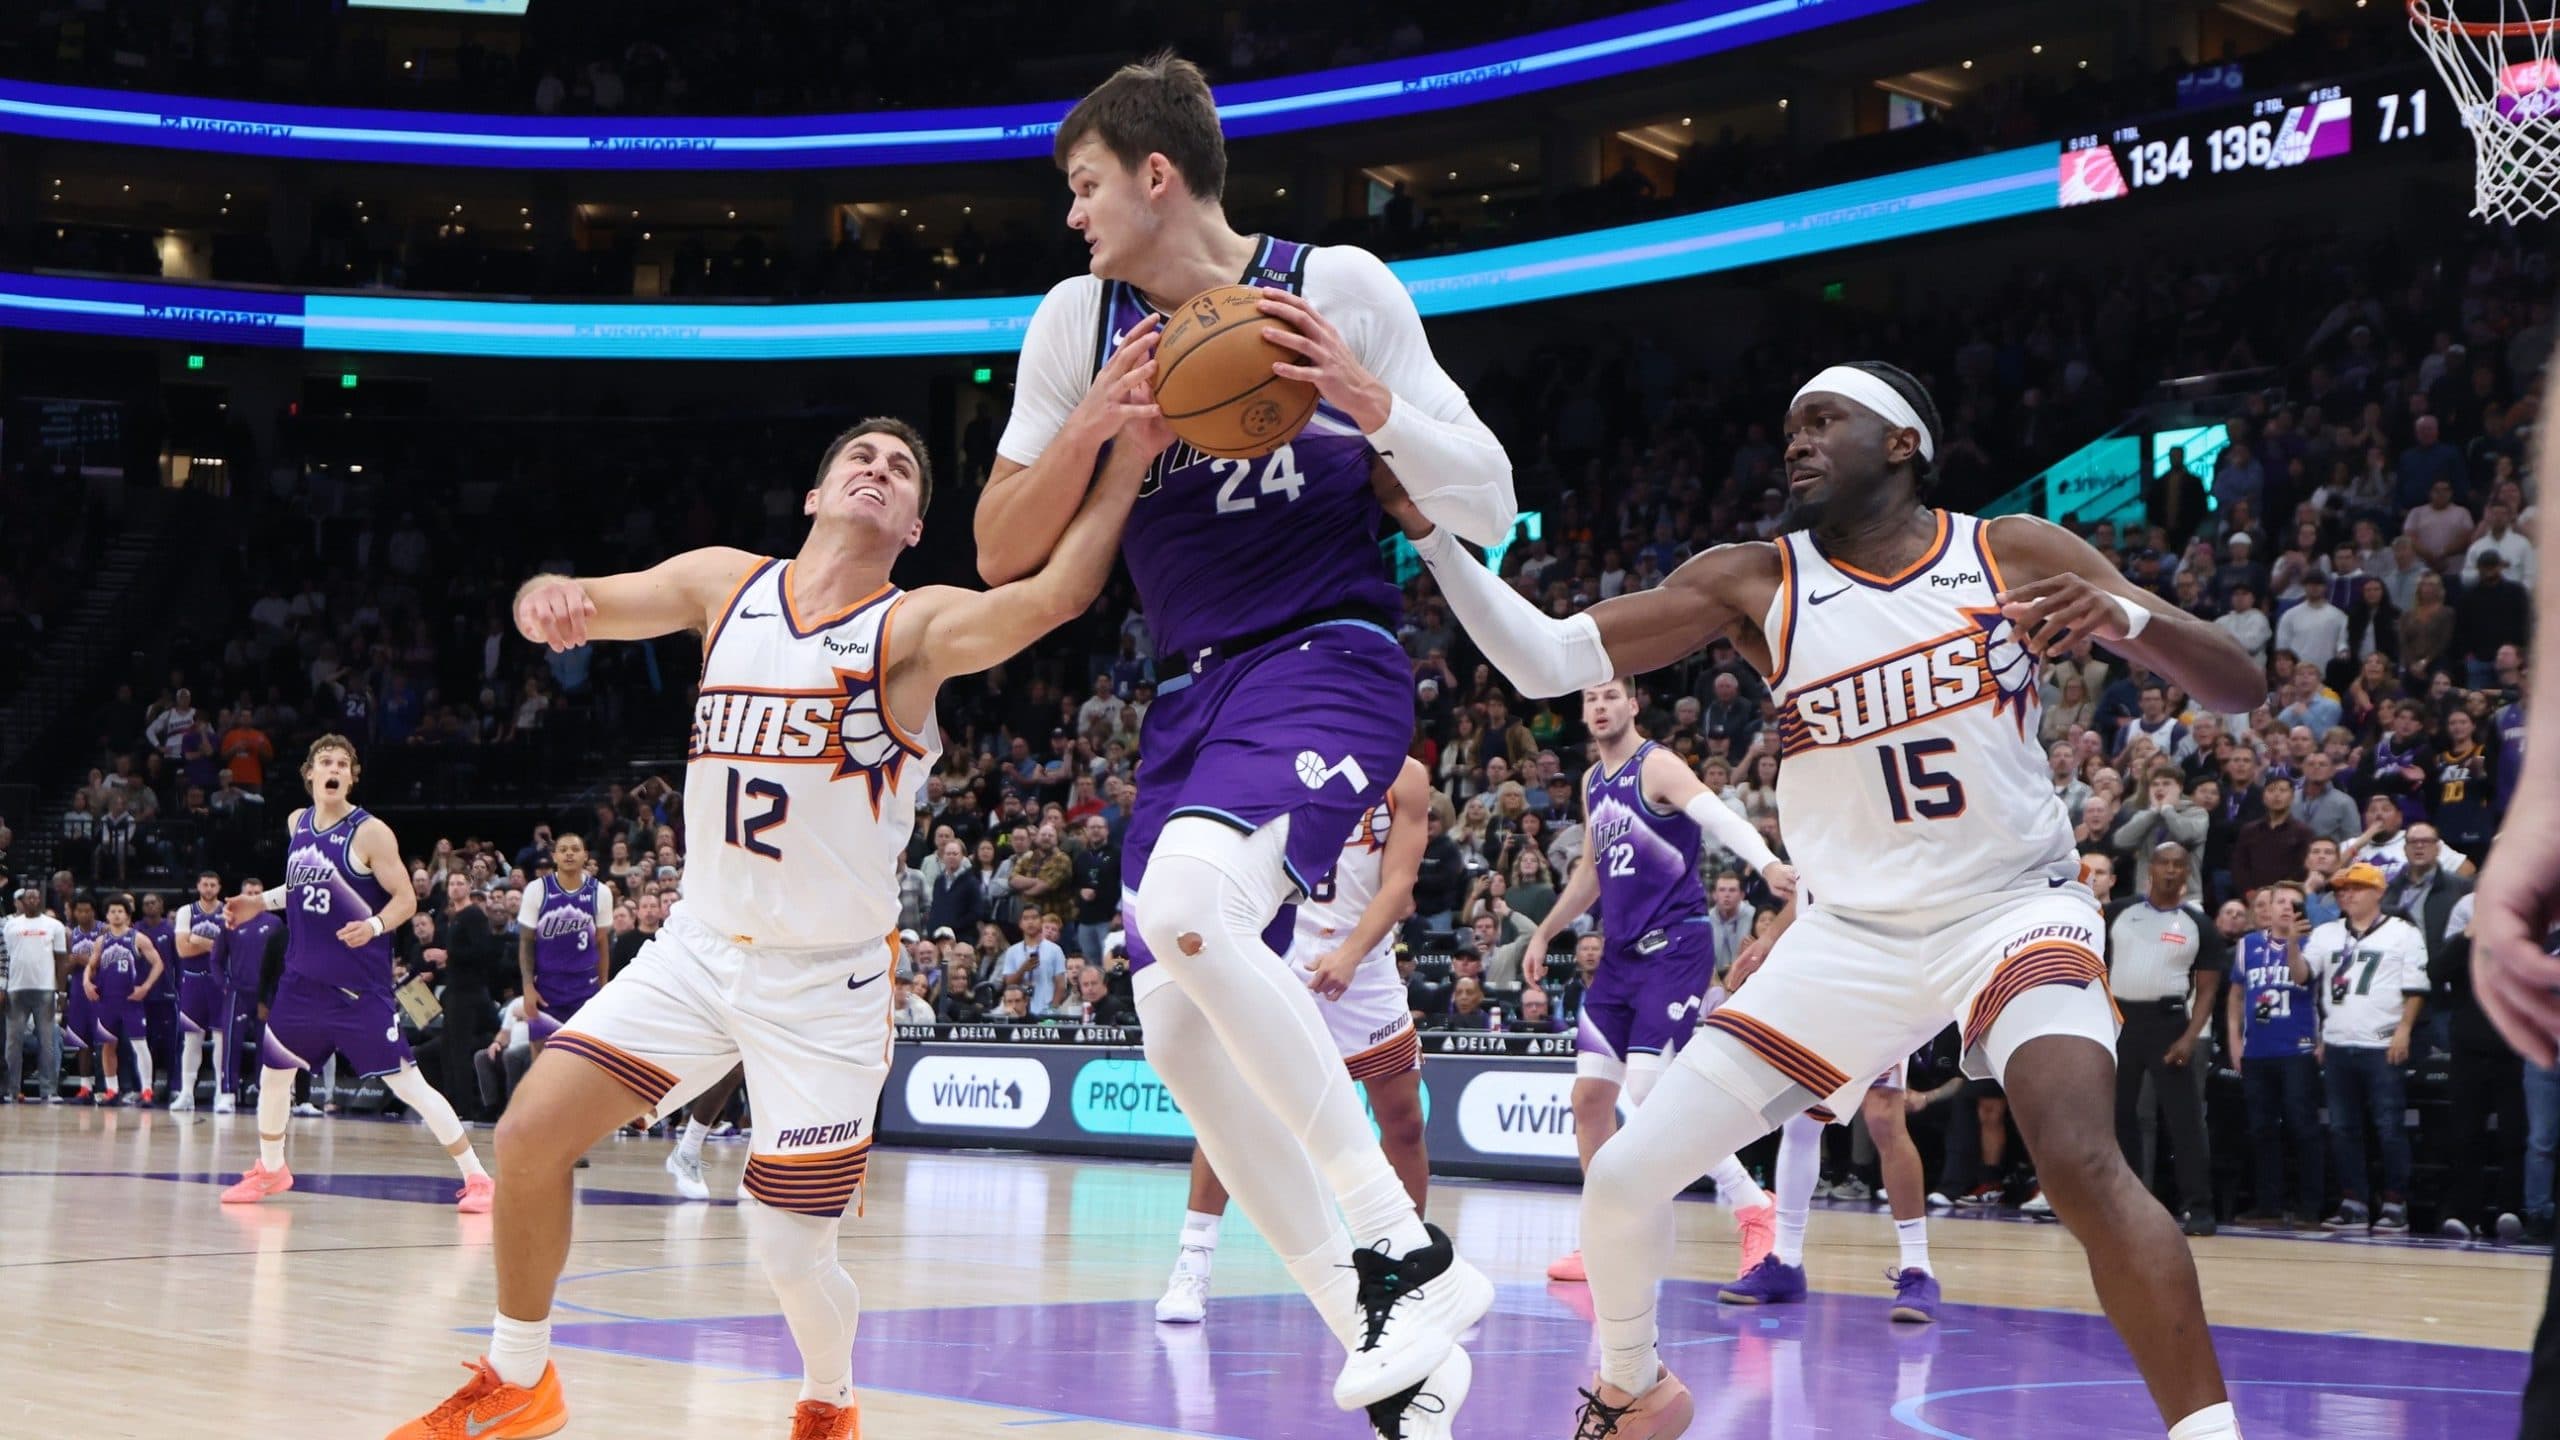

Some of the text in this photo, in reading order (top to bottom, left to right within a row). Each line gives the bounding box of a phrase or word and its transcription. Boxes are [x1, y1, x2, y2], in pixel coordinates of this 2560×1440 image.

[2320, 85, 2342, 101] FLS
[2253, 101, 2264, 117] 2
[2377, 89, 2426, 143] 7.1
[2079, 134, 2099, 149] FLS
[2206, 120, 2272, 174] 136
[2128, 136, 2193, 188] 134
[1210, 443, 1306, 515] 24
[1930, 571, 1982, 590] PayPal
[822, 636, 869, 656] PayPal
[1796, 636, 1981, 745] SUNS
[695, 693, 834, 757] SUNS
[1875, 737, 1968, 824] 15
[725, 766, 789, 862] 12
[1592, 816, 1633, 864] UTAH
[287, 859, 334, 892] UTAH
[1608, 843, 1636, 878] 22
[302, 884, 331, 915] 23
[542, 915, 593, 939] UTAH
[577, 931, 589, 951] 3
[2003, 925, 2093, 960] PHOENIX
[1420, 955, 1452, 964] DELTA
[902, 1026, 935, 1038] DELTA
[961, 1026, 997, 1039] DELTA
[1023, 1027, 1060, 1040] DELTA
[1088, 1028, 1127, 1040] DELTA
[1457, 1037, 1507, 1050] DELTA
[1544, 1039, 1575, 1051] DEL
[1497, 1093, 1576, 1134] vivin
[777, 1117, 863, 1149] PHOENIX
